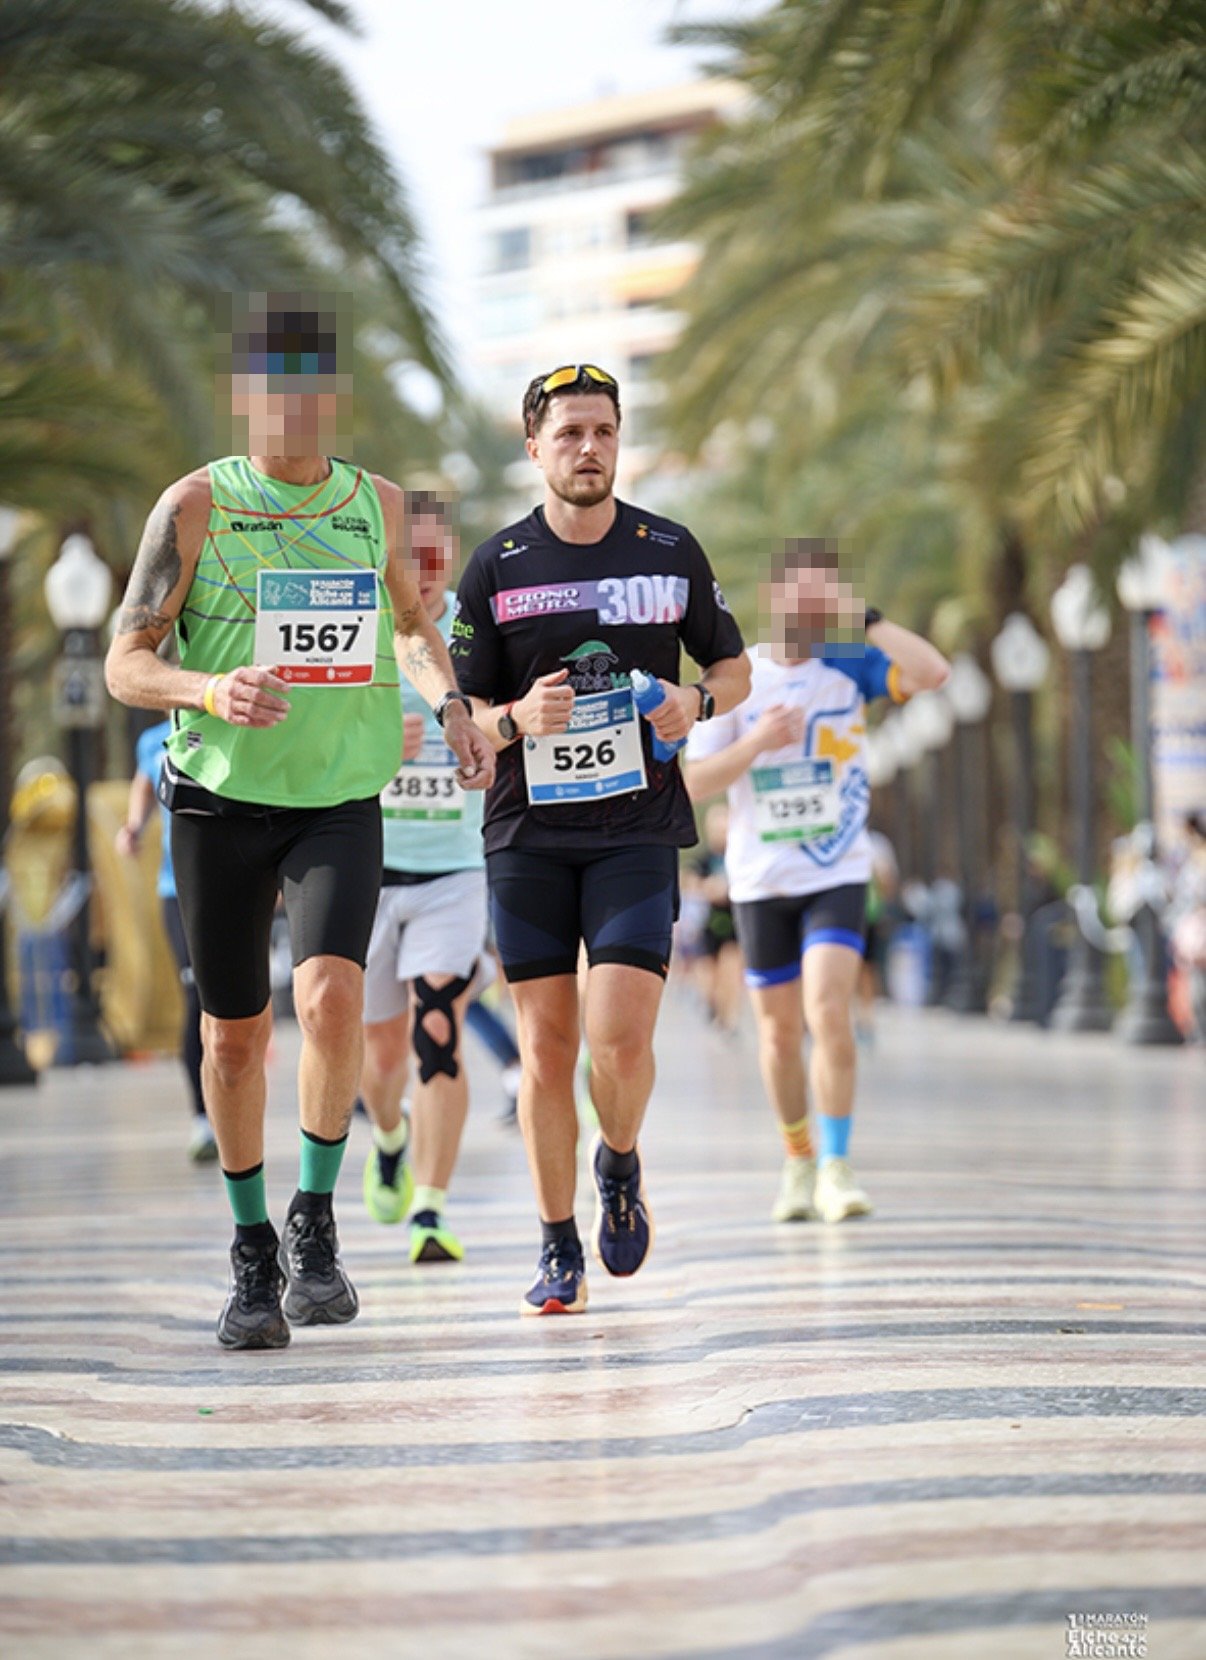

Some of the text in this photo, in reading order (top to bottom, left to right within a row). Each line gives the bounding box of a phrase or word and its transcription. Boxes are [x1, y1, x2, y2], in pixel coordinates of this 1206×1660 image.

[505, 588, 579, 606] CRONO
[507, 598, 580, 616] METRA
[597, 574, 681, 624] 30K
[278, 623, 360, 653] 1567
[553, 739, 616, 772] 526
[390, 775, 455, 798] 3833
